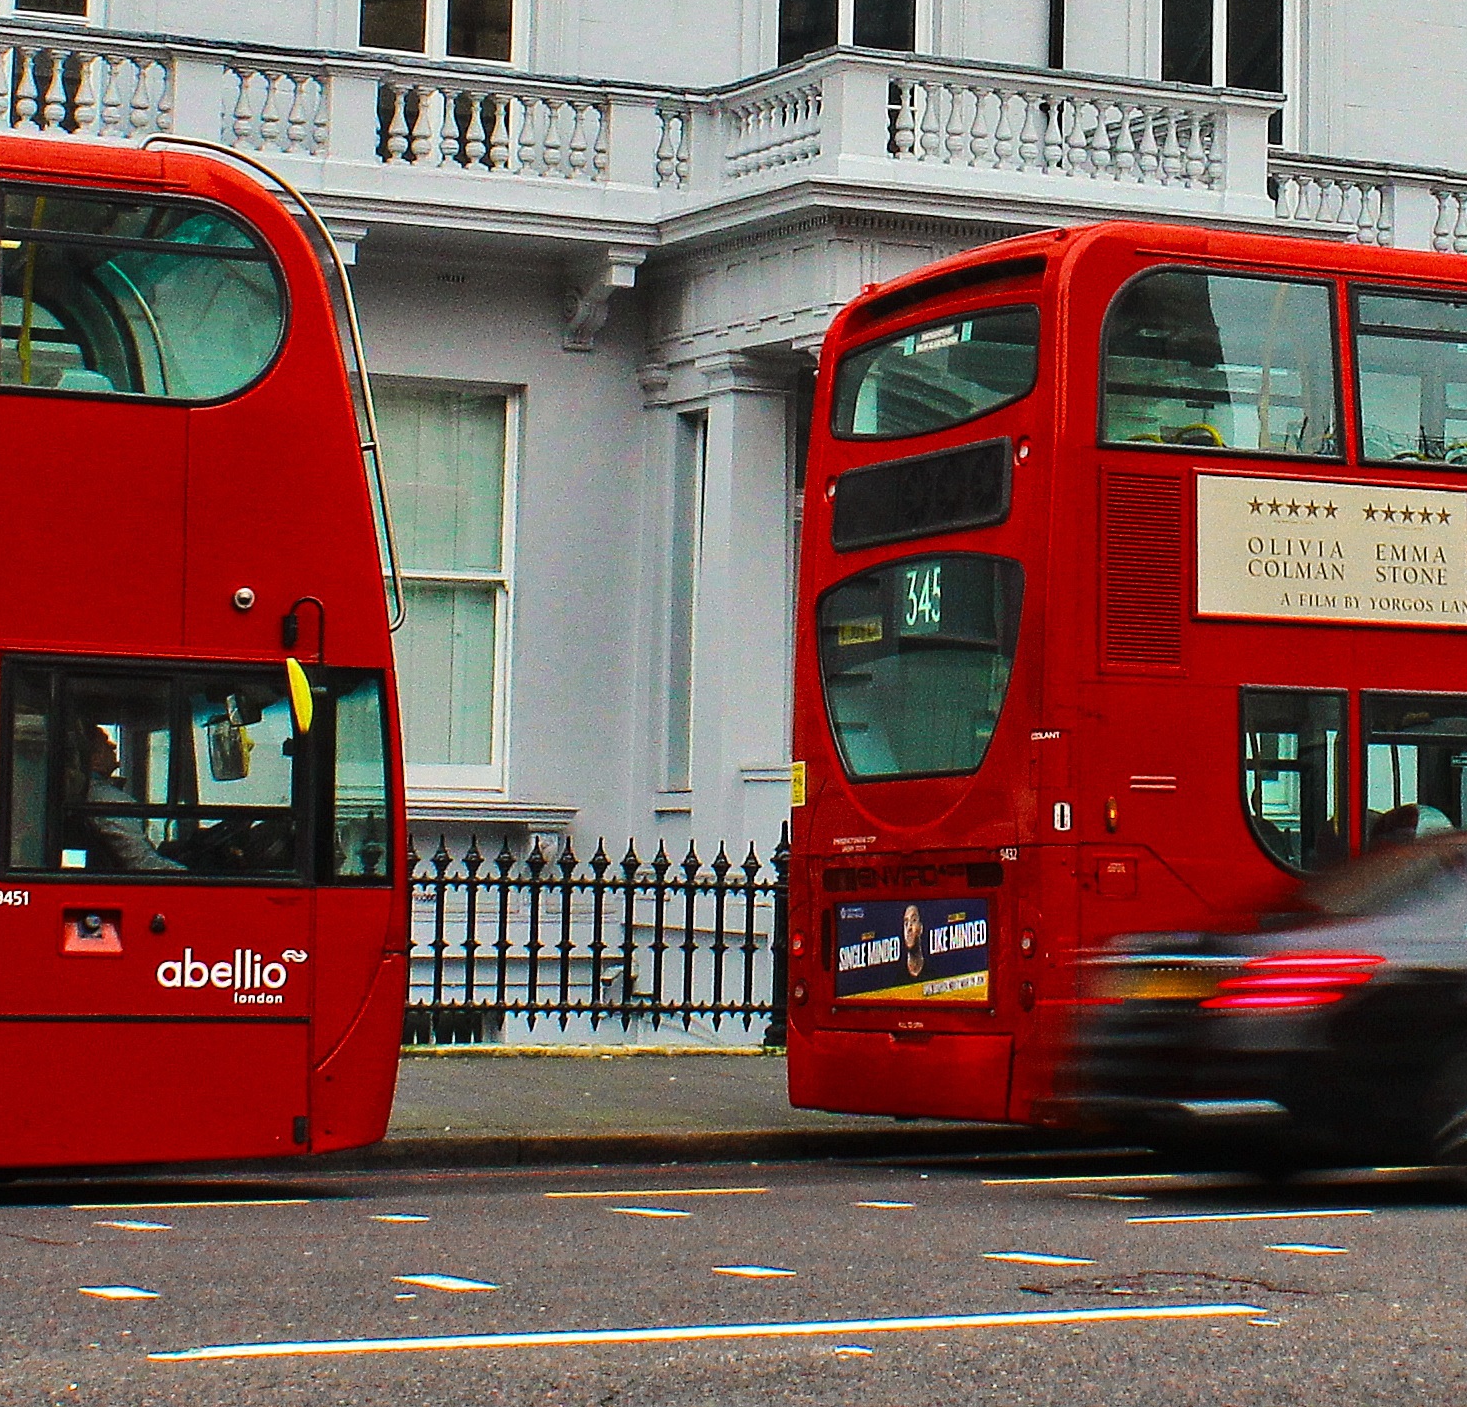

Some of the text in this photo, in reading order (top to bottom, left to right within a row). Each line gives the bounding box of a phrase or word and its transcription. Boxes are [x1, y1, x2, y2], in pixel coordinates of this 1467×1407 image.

[1248, 537, 1344, 559] OLIVIA
[1375, 543, 1447, 565] EMMA
[1247, 559, 1346, 581] COLMAN
[1375, 566, 1448, 586] STONE
[905, 566, 941, 626] 345
[1280, 592, 1292, 607] A
[1299, 593, 1337, 609] FILM
[1344, 596, 1362, 609] BY
[1369, 597, 1434, 613] YORGOS
[930, 919, 987, 955] LIKE MINDED
[839, 936, 901, 971] SINGLE MINDED
[156, 948, 287, 990] abellio
[233, 992, 284, 1004] london
